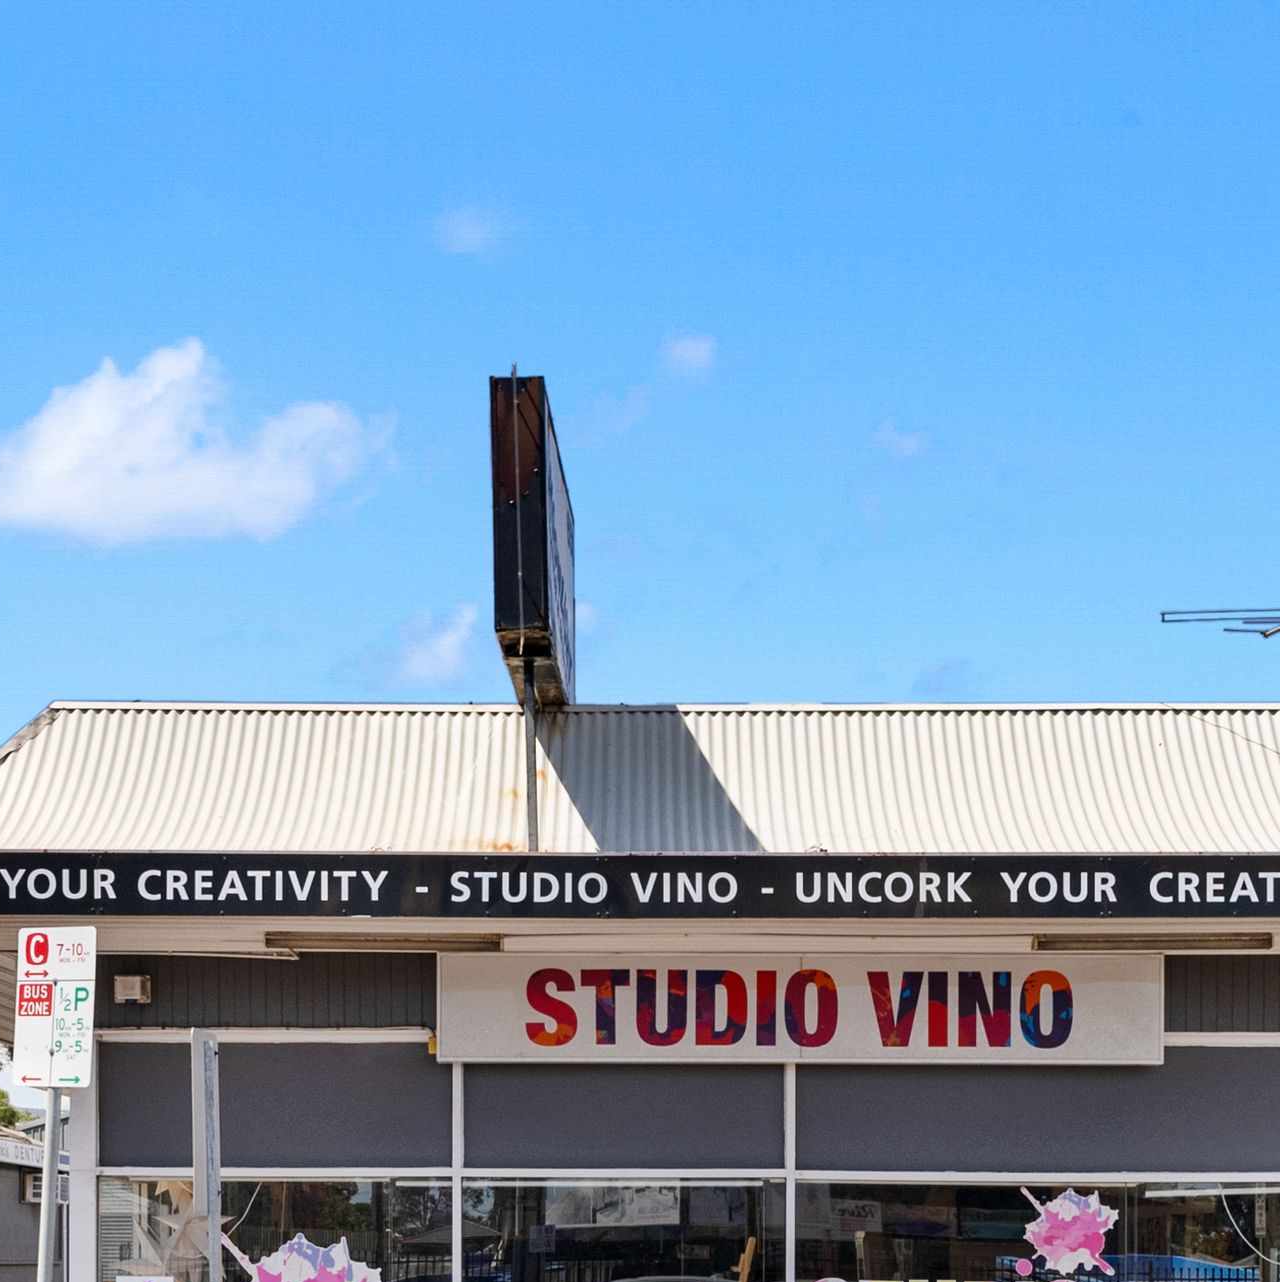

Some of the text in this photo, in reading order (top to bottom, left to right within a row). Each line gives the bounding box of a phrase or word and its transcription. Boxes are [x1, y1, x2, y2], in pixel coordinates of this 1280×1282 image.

[0, 868, 117, 901] YOUR
[137, 869, 389, 902] CREATIVITY
[451, 870, 607, 903] STUDIO
[633, 871, 738, 903] VINO
[795, 871, 972, 904] UNCORK
[1000, 871, 1118, 904] YOUR
[23, 985, 48, 999] BUS
[20, 1001, 50, 1015] ZONE
[525, 967, 1074, 1049] STUDIO VINO
